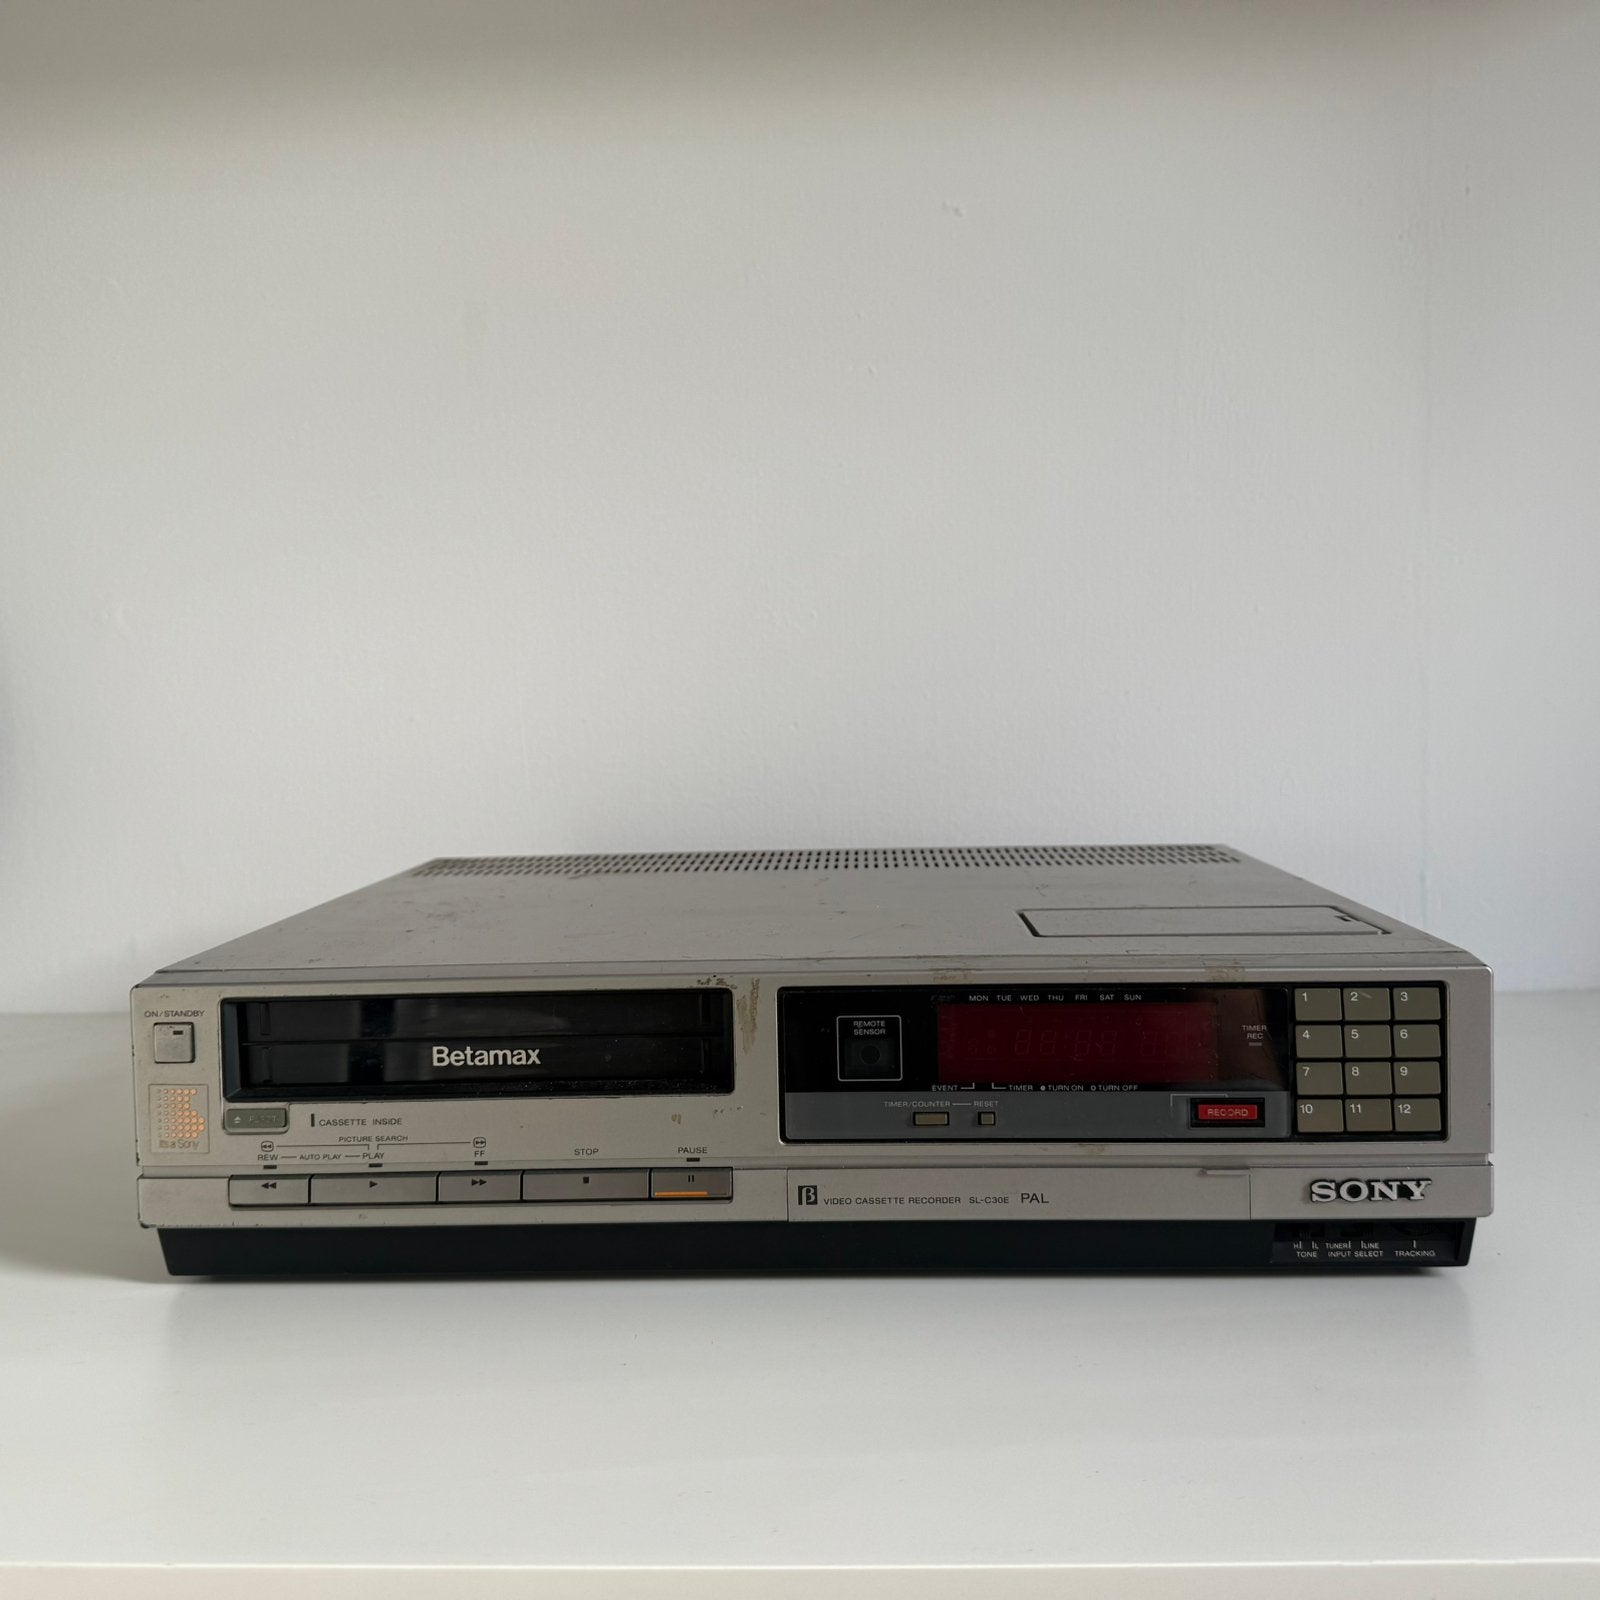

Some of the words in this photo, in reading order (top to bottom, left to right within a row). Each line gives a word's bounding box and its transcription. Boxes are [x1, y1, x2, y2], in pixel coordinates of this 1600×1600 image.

[969, 994, 989, 1002] MON
[996, 994, 1013, 1002] TUE
[1020, 994, 1040, 1002] WED
[1048, 994, 1065, 1002] THU
[1100, 993, 1115, 1001] SAT
[1124, 993, 1142, 1001] SUN
[1302, 992, 1308, 1002] 1
[1350, 991, 1358, 1002] 2
[1400, 991, 1408, 1002] 3
[853, 1020, 886, 1028] REMOTE
[1242, 1024, 1267, 1032] TIMER
[853, 1028, 886, 1036] SENSOR
[1247, 1032, 1264, 1040] REC
[1302, 1030, 1310, 1040] 4
[1351, 1029, 1359, 1039] 5
[1400, 1029, 1408, 1039] 6
[432, 1045, 542, 1067] Betamax
[1302, 1067, 1310, 1077] 7
[1351, 1066, 1360, 1077] 8
[1400, 1066, 1408, 1076] 9
[1008, 1084, 1033, 1092] TIMER
[1047, 1084, 1070, 1092] TURN
[1071, 1084, 1084, 1092] ON
[1098, 1084, 1120, 1092] TURN
[1122, 1084, 1139, 1092] OFF
[884, 1100, 950, 1108] TIMER/COUNTER
[973, 1100, 999, 1108] RESET
[1300, 1104, 1313, 1114] 10
[1350, 1104, 1362, 1114] 11
[1398, 1104, 1411, 1114] 12
[1207, 1107, 1248, 1117] RECORD
[319, 1118, 367, 1127] CASSETTE
[372, 1117, 402, 1126] INSIDE
[338, 1135, 373, 1143] PICTURE
[376, 1134, 409, 1142] SEARCH
[474, 1150, 485, 1158] FF
[574, 1148, 599, 1156] STOP
[678, 1146, 708, 1155] PAUSE
[257, 1153, 278, 1161] REW
[299, 1153, 321, 1161] AUTO
[322, 1152, 342, 1160] PLAY
[362, 1152, 384, 1160] PLAY
[1310, 1178, 1432, 1202] SONY
[823, 1197, 852, 1205] VIDEO
[855, 1197, 905, 1205] CASSETTE
[1020, 1193, 1050, 1204] PAL
[1328, 1250, 1351, 1258] INPUT
[1354, 1250, 1384, 1258] SELECT
[1394, 1250, 1436, 1258] TRACKING
